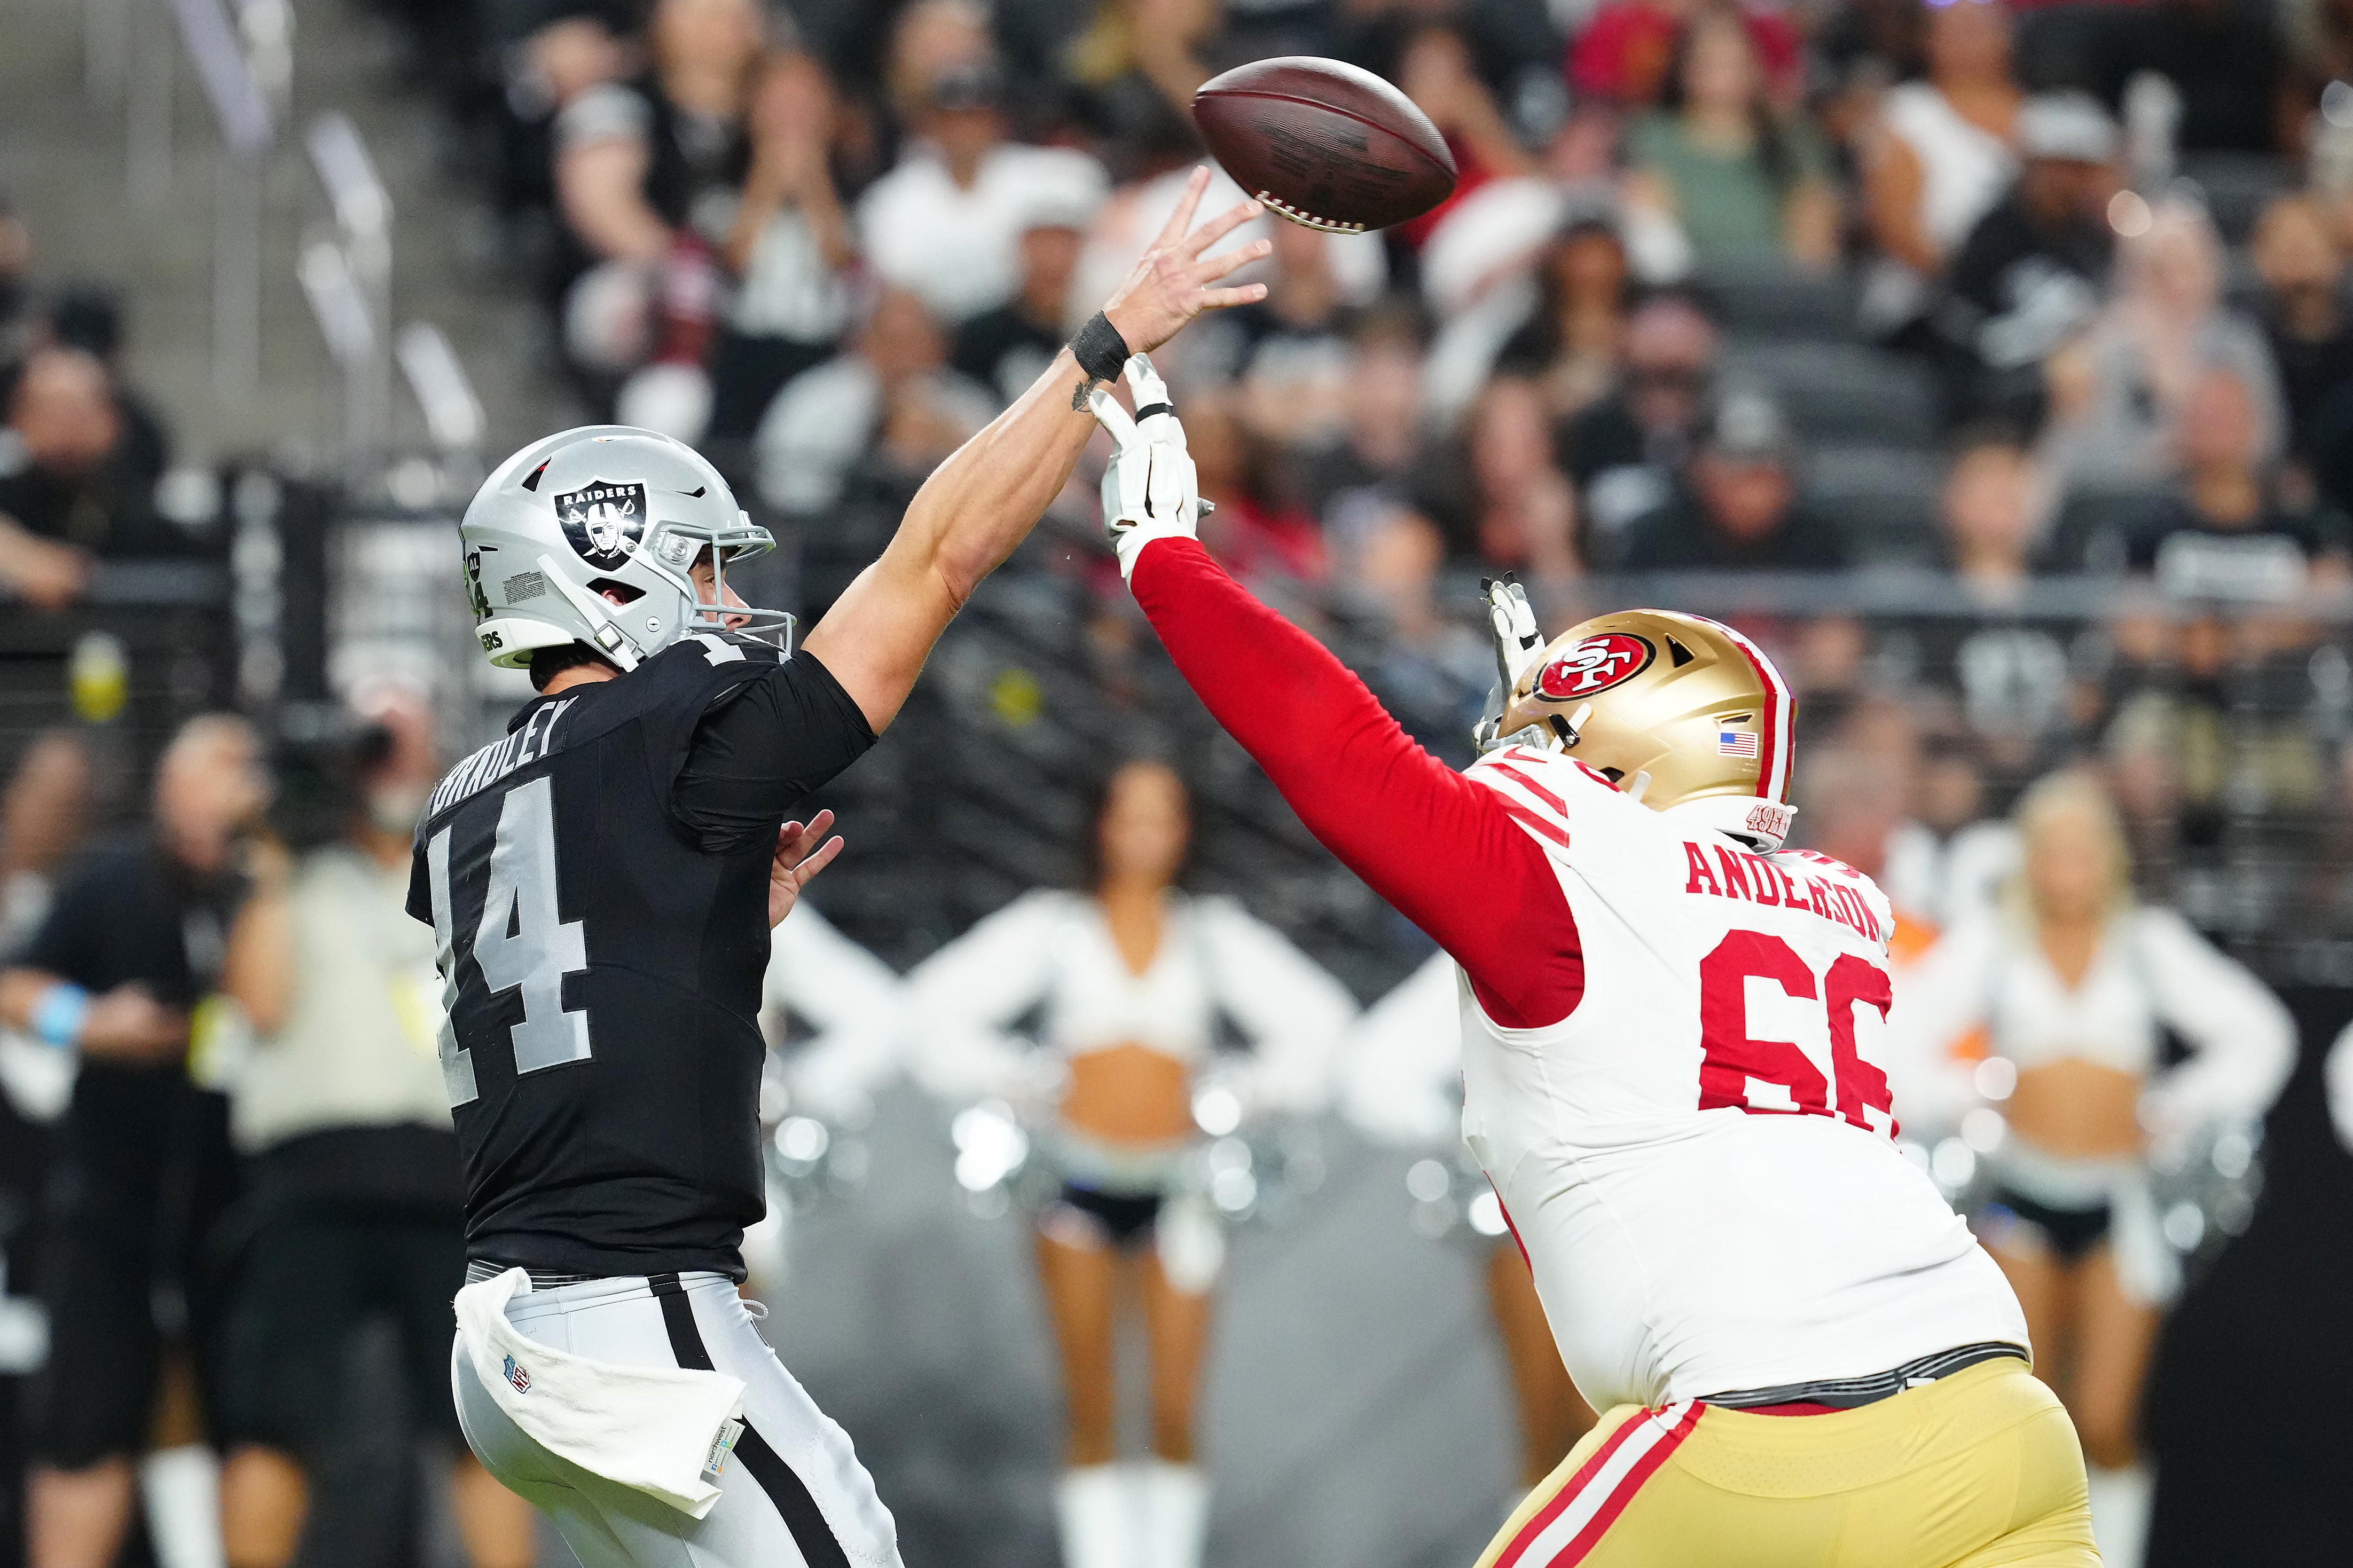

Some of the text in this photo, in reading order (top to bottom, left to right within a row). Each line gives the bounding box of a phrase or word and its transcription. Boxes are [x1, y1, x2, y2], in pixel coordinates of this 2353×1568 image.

[563, 486, 636, 506] RAIDERS
[469, 557, 479, 572] AL
[1560, 639, 1631, 691] SF
[430, 695, 579, 817] BRADLEY
[1682, 841, 1880, 942] ANDERSON
[428, 776, 592, 1109] 14
[1698, 929, 1901, 1142] 66
[512, 1366, 528, 1391] NFL
